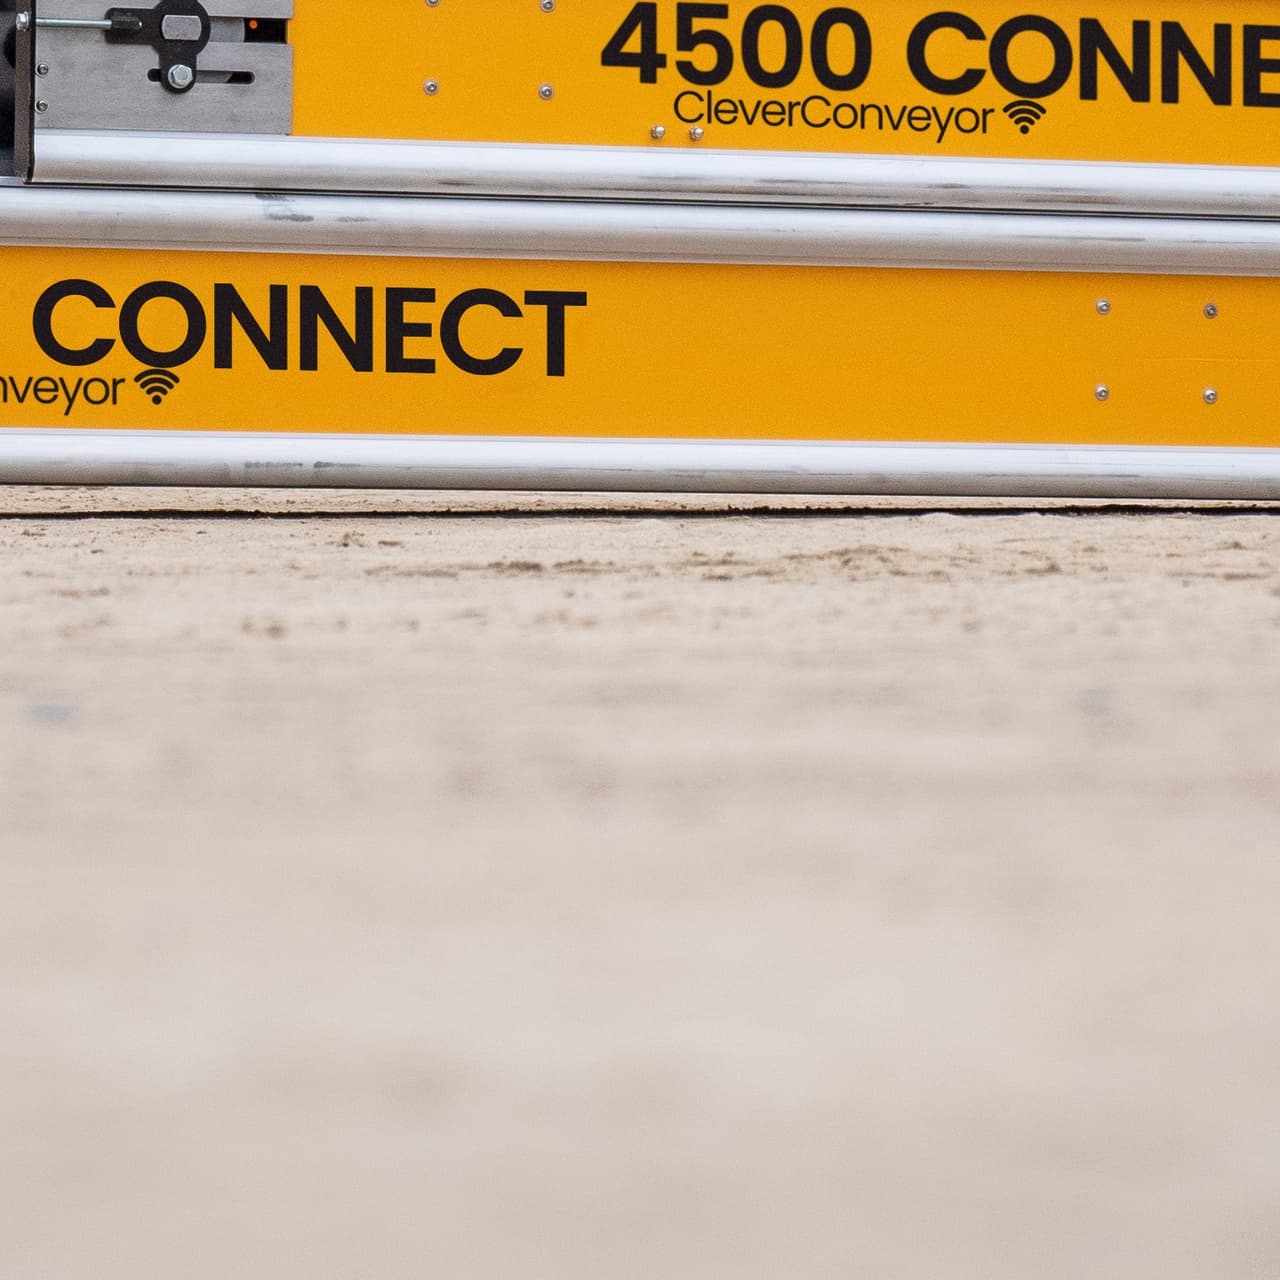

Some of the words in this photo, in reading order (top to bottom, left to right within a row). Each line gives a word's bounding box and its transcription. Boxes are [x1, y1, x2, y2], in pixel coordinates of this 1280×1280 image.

[600, 1, 872, 92] 4500
[673, 89, 995, 144] CleverConveyor
[32, 278, 588, 377] CONNECT
